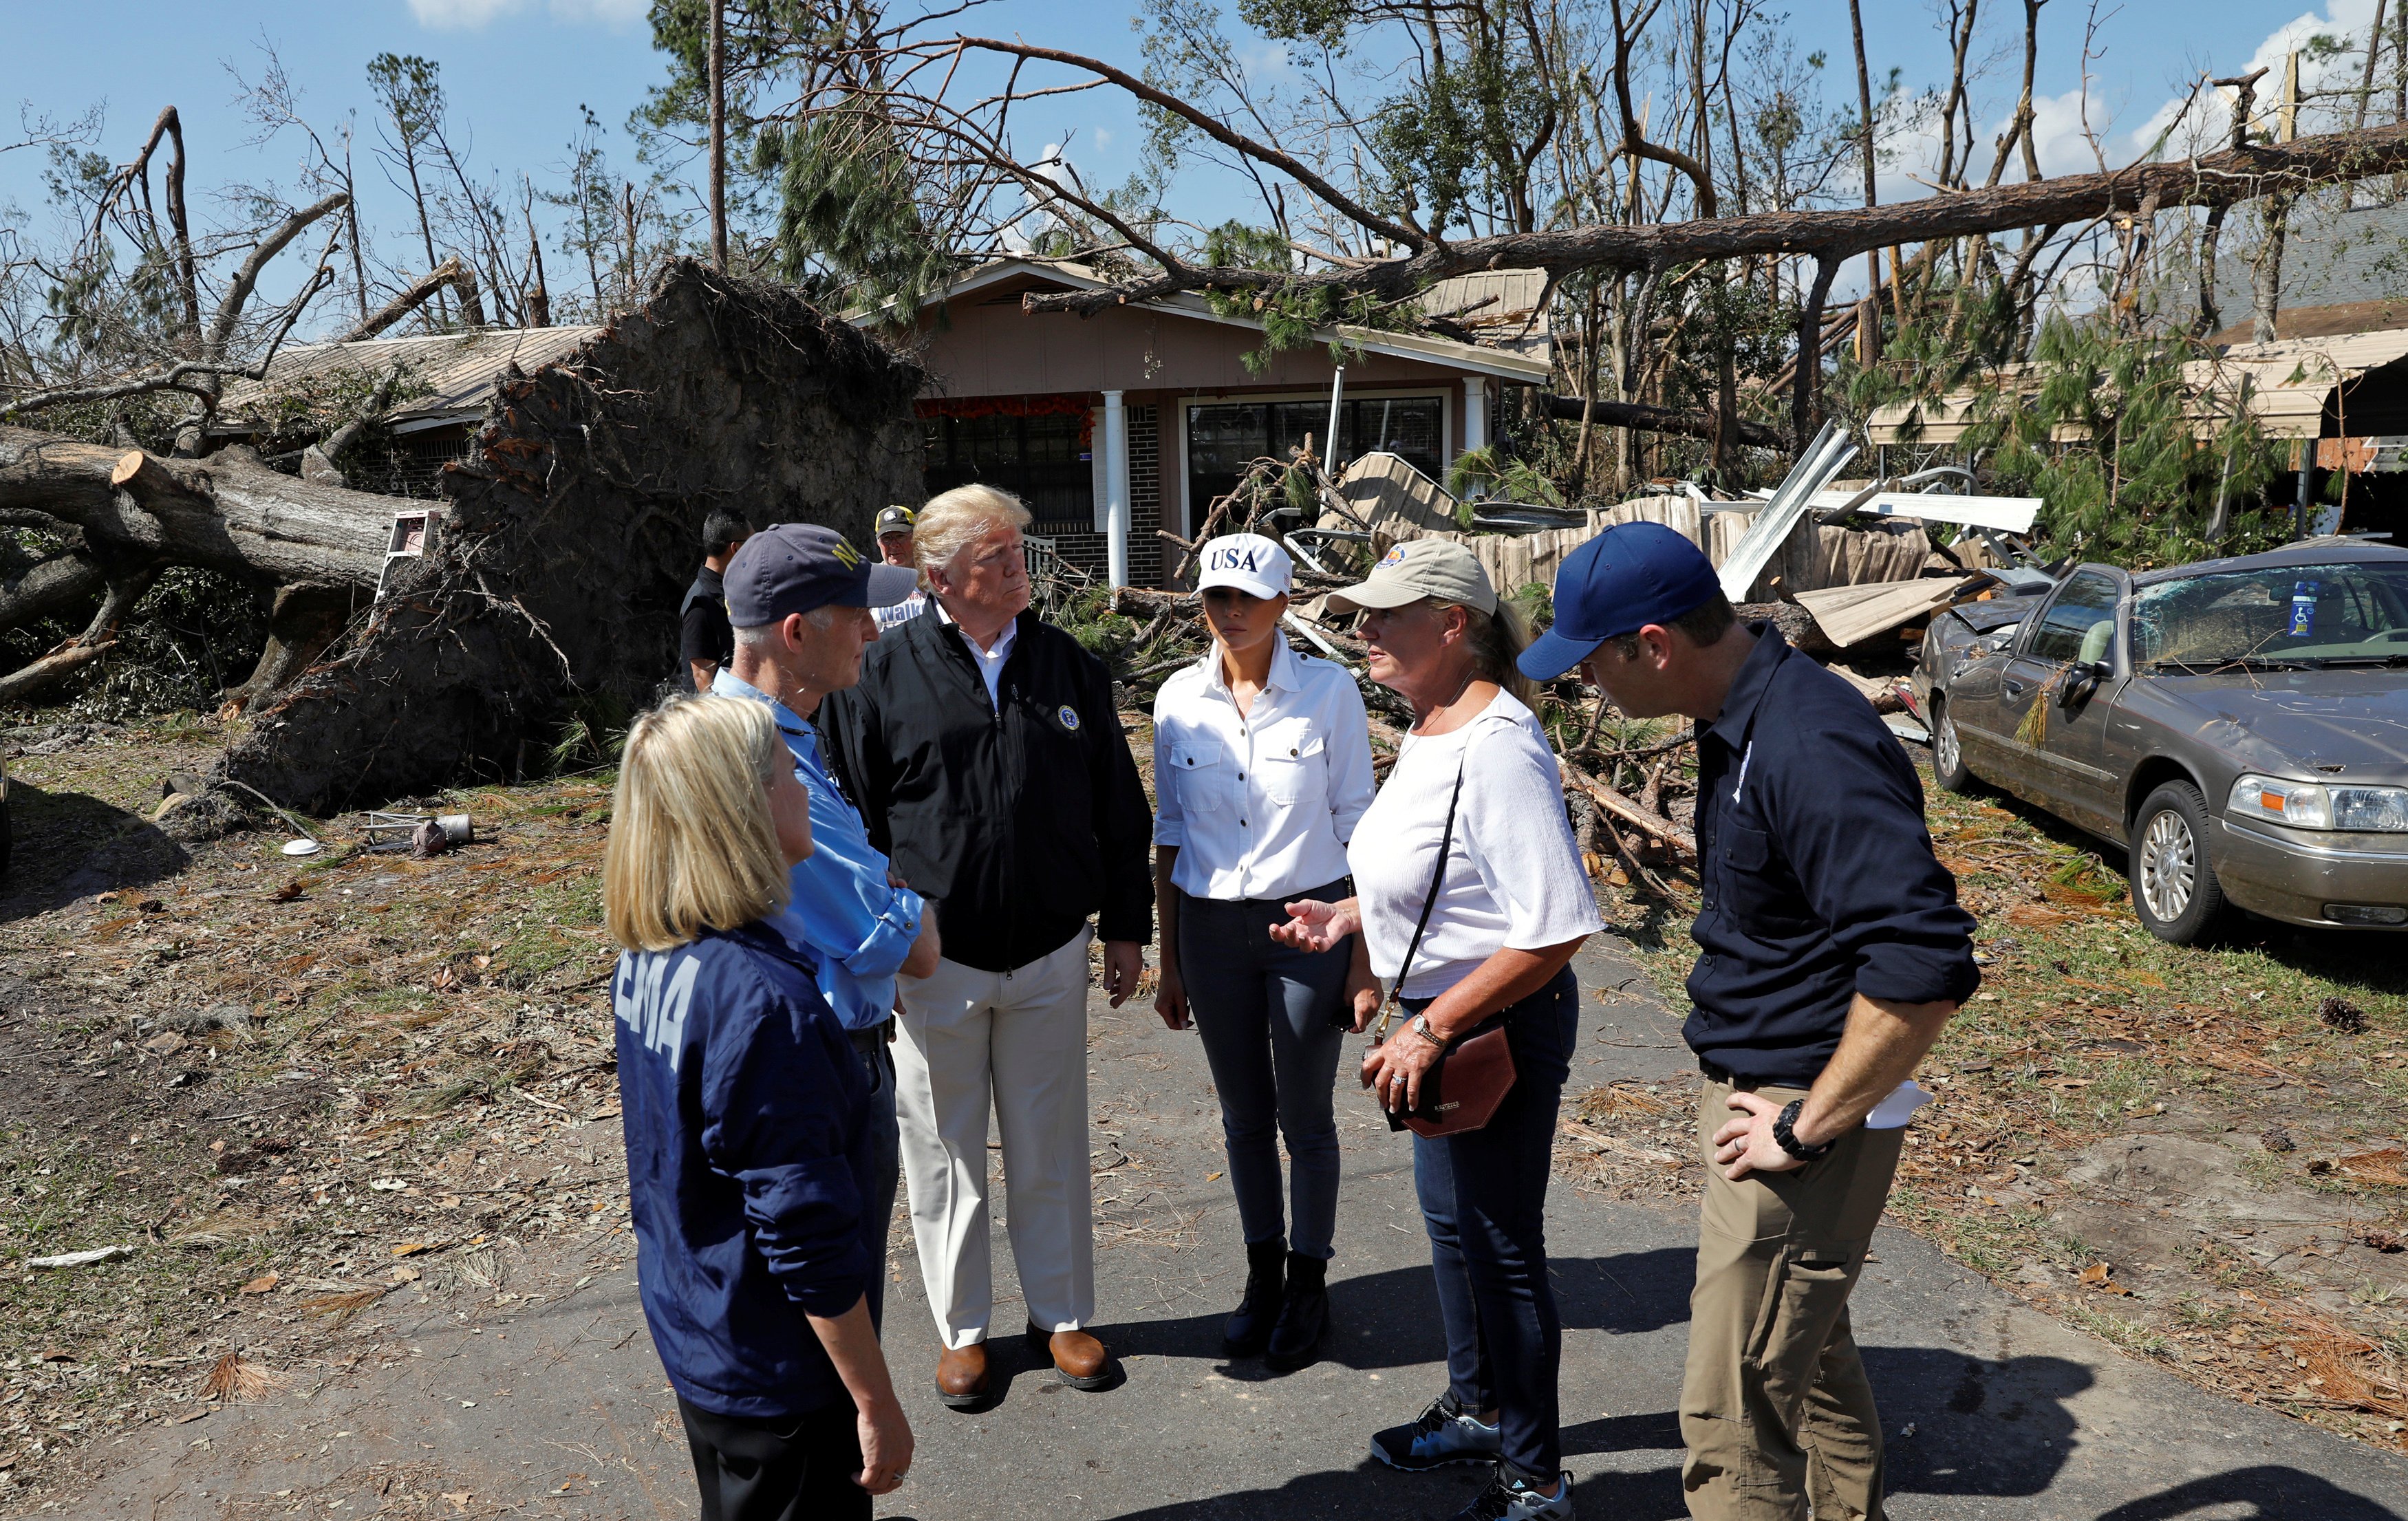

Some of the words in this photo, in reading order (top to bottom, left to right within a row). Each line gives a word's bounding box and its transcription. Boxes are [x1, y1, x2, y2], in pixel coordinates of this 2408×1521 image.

[1211, 548, 1258, 572] USA
[879, 603, 925, 623] Walk
[614, 948, 700, 1073] EMA
